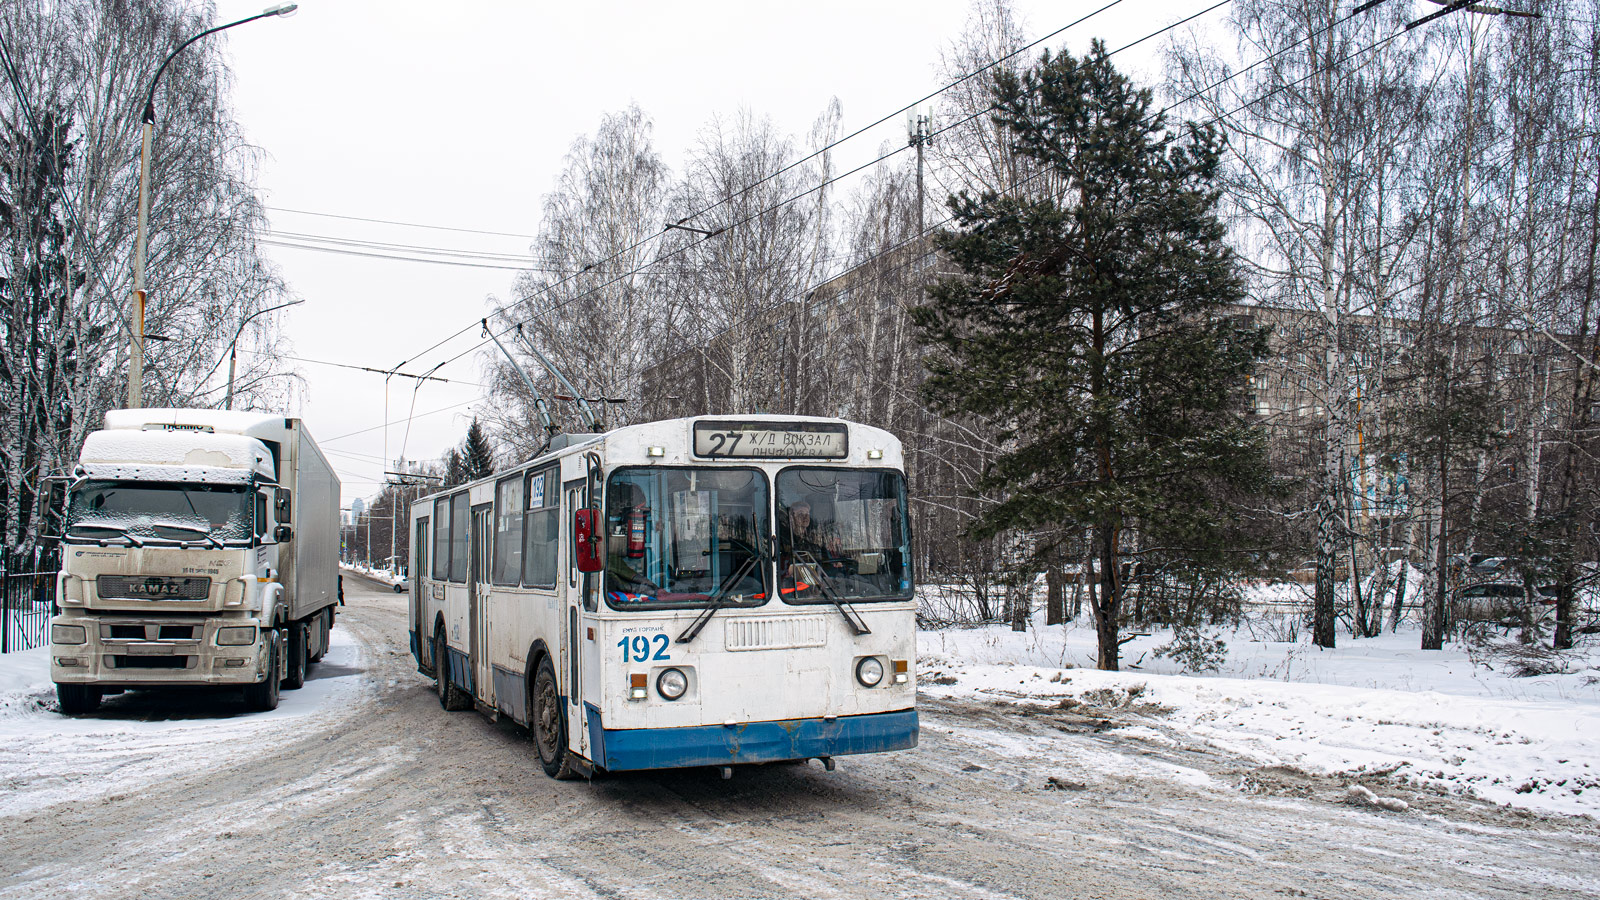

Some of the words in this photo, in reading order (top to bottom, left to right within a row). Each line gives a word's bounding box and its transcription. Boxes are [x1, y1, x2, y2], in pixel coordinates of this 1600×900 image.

[708, 433, 743, 456] 27
[749, 432, 776, 445] Ж/Д
[783, 433, 831, 446] ВОКЗАЛ
[533, 476, 544, 498] 192
[129, 584, 179, 594] KAMAZ
[617, 634, 671, 663] 192
